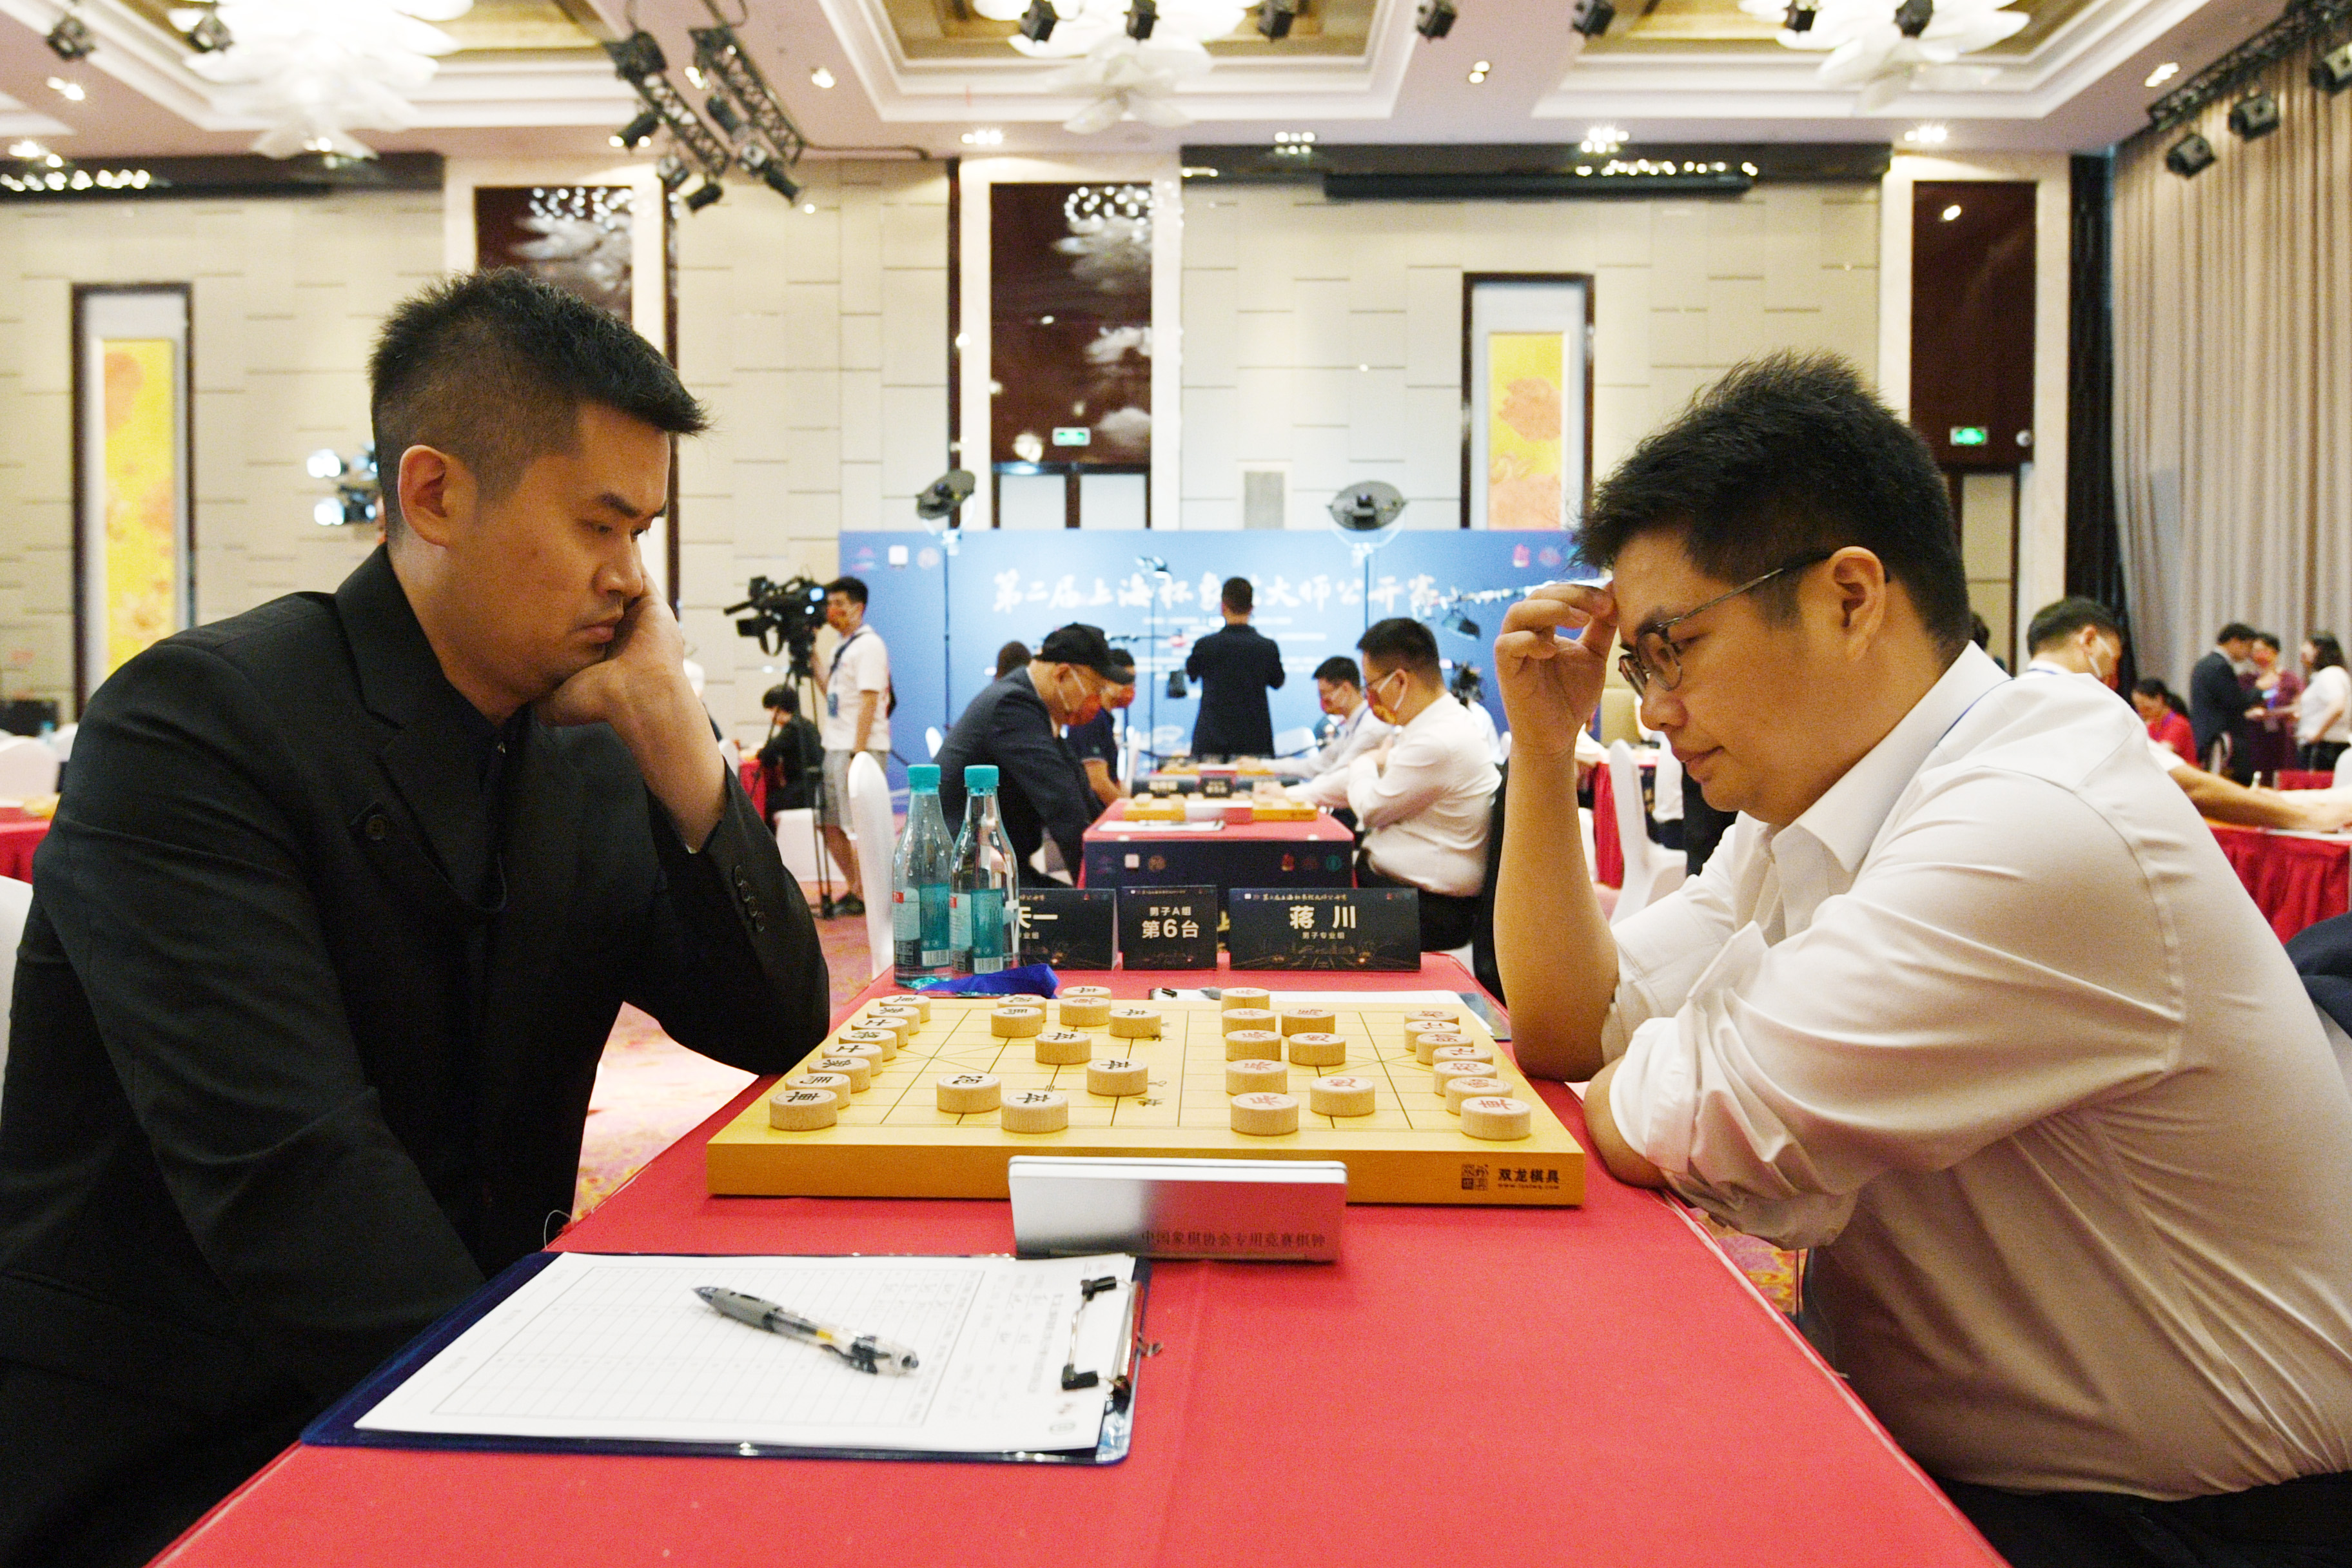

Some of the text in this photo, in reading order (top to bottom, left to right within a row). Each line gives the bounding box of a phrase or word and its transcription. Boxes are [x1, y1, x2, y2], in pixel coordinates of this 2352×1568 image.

[993, 569, 1440, 616] 第二届上海杯象大师公开赛
[1150, 906, 1191, 916] 男子A组
[1289, 905, 1356, 929] 蒋 川
[1142, 919, 1199, 939] 第6台
[1100, 1060, 1132, 1069] 卒
[1244, 1062, 1272, 1070] 兵
[1451, 1063, 1480, 1072] 相
[786, 1092, 821, 1102] 車
[1016, 1093, 1051, 1104] 卒
[1250, 1095, 1282, 1106] 兵
[1478, 1099, 1513, 1110] 車
[1498, 1168, 1559, 1184] 双龙棋具
